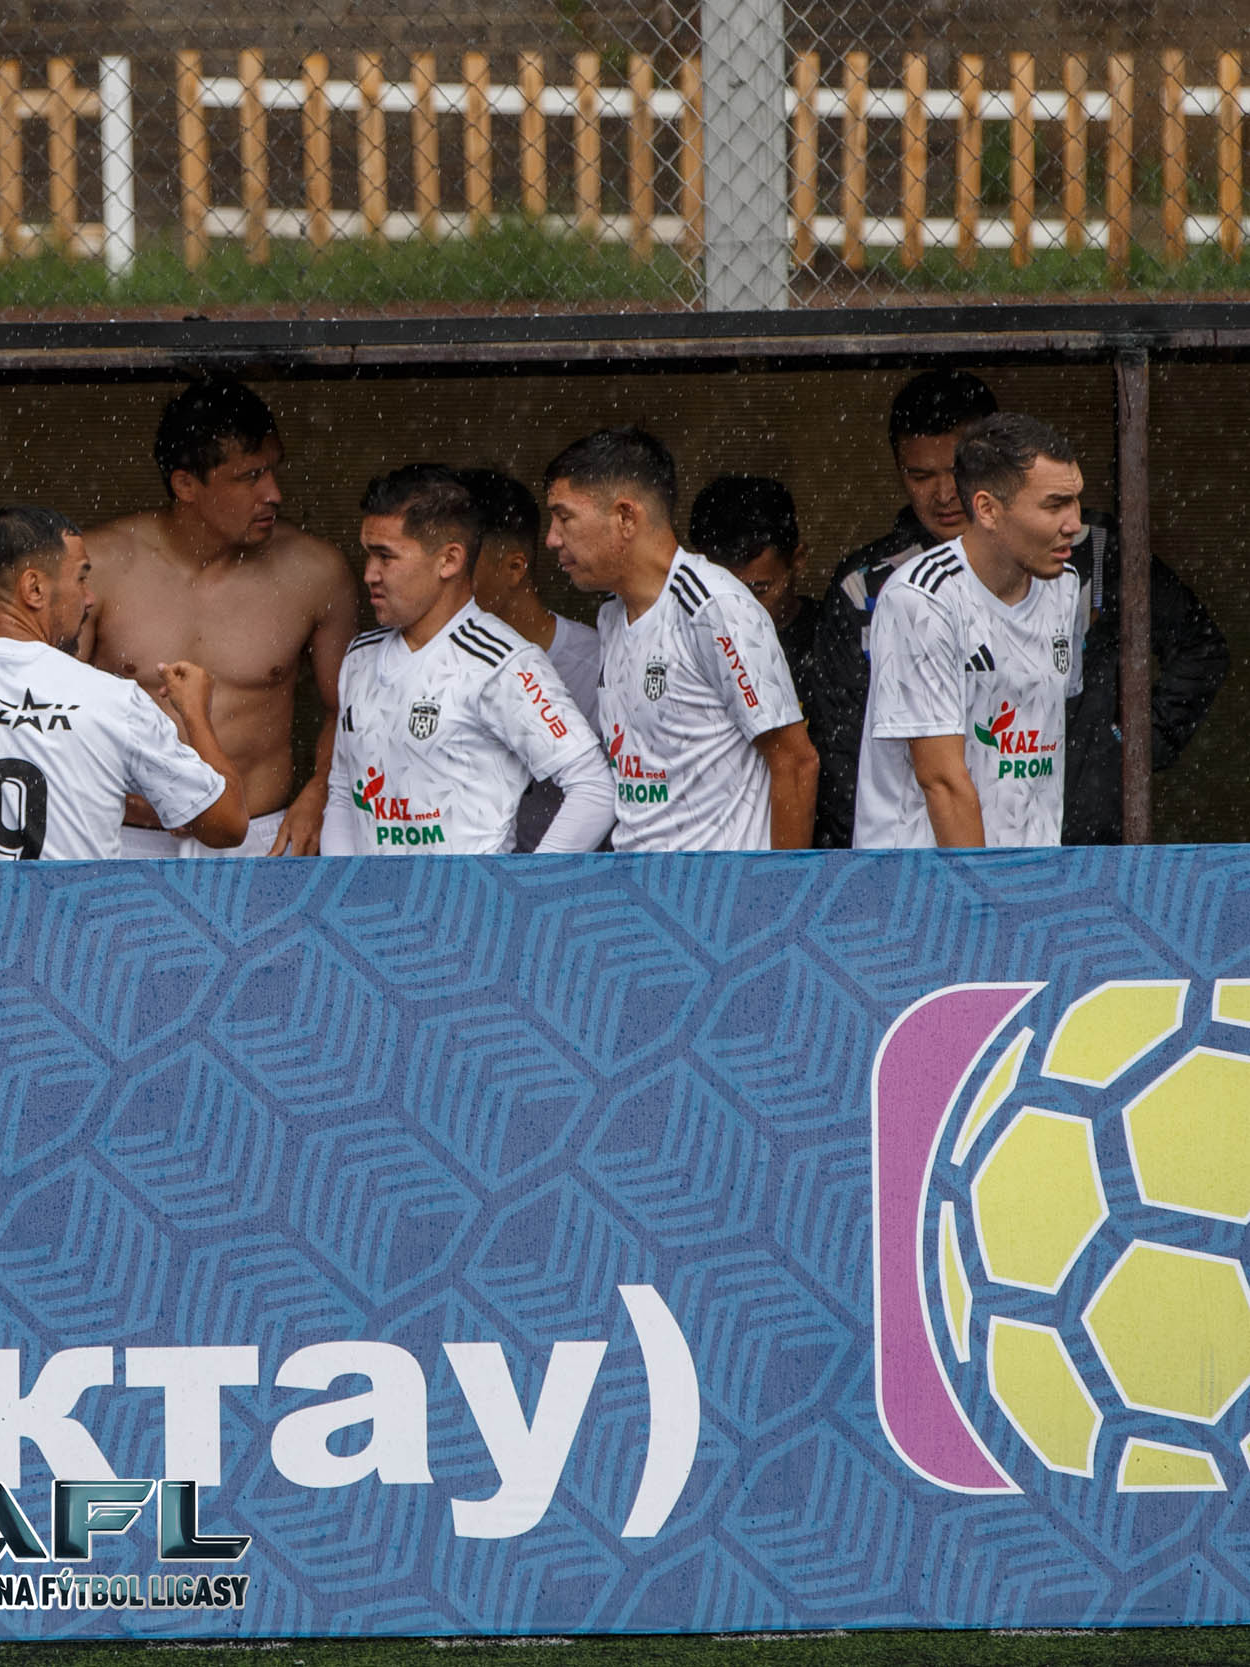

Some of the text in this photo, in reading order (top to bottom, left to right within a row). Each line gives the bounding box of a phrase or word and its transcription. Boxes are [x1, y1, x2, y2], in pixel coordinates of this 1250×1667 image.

[717, 637, 759, 708] AIYUB
[517, 672, 568, 739] AIYUB
[999, 729, 1057, 755] KAZ med
[618, 754, 667, 779] KAZ med
[998, 757, 1053, 779] PROM
[618, 783, 669, 804] PROM
[374, 797, 441, 821] KAZ med
[376, 824, 446, 846] PROM
